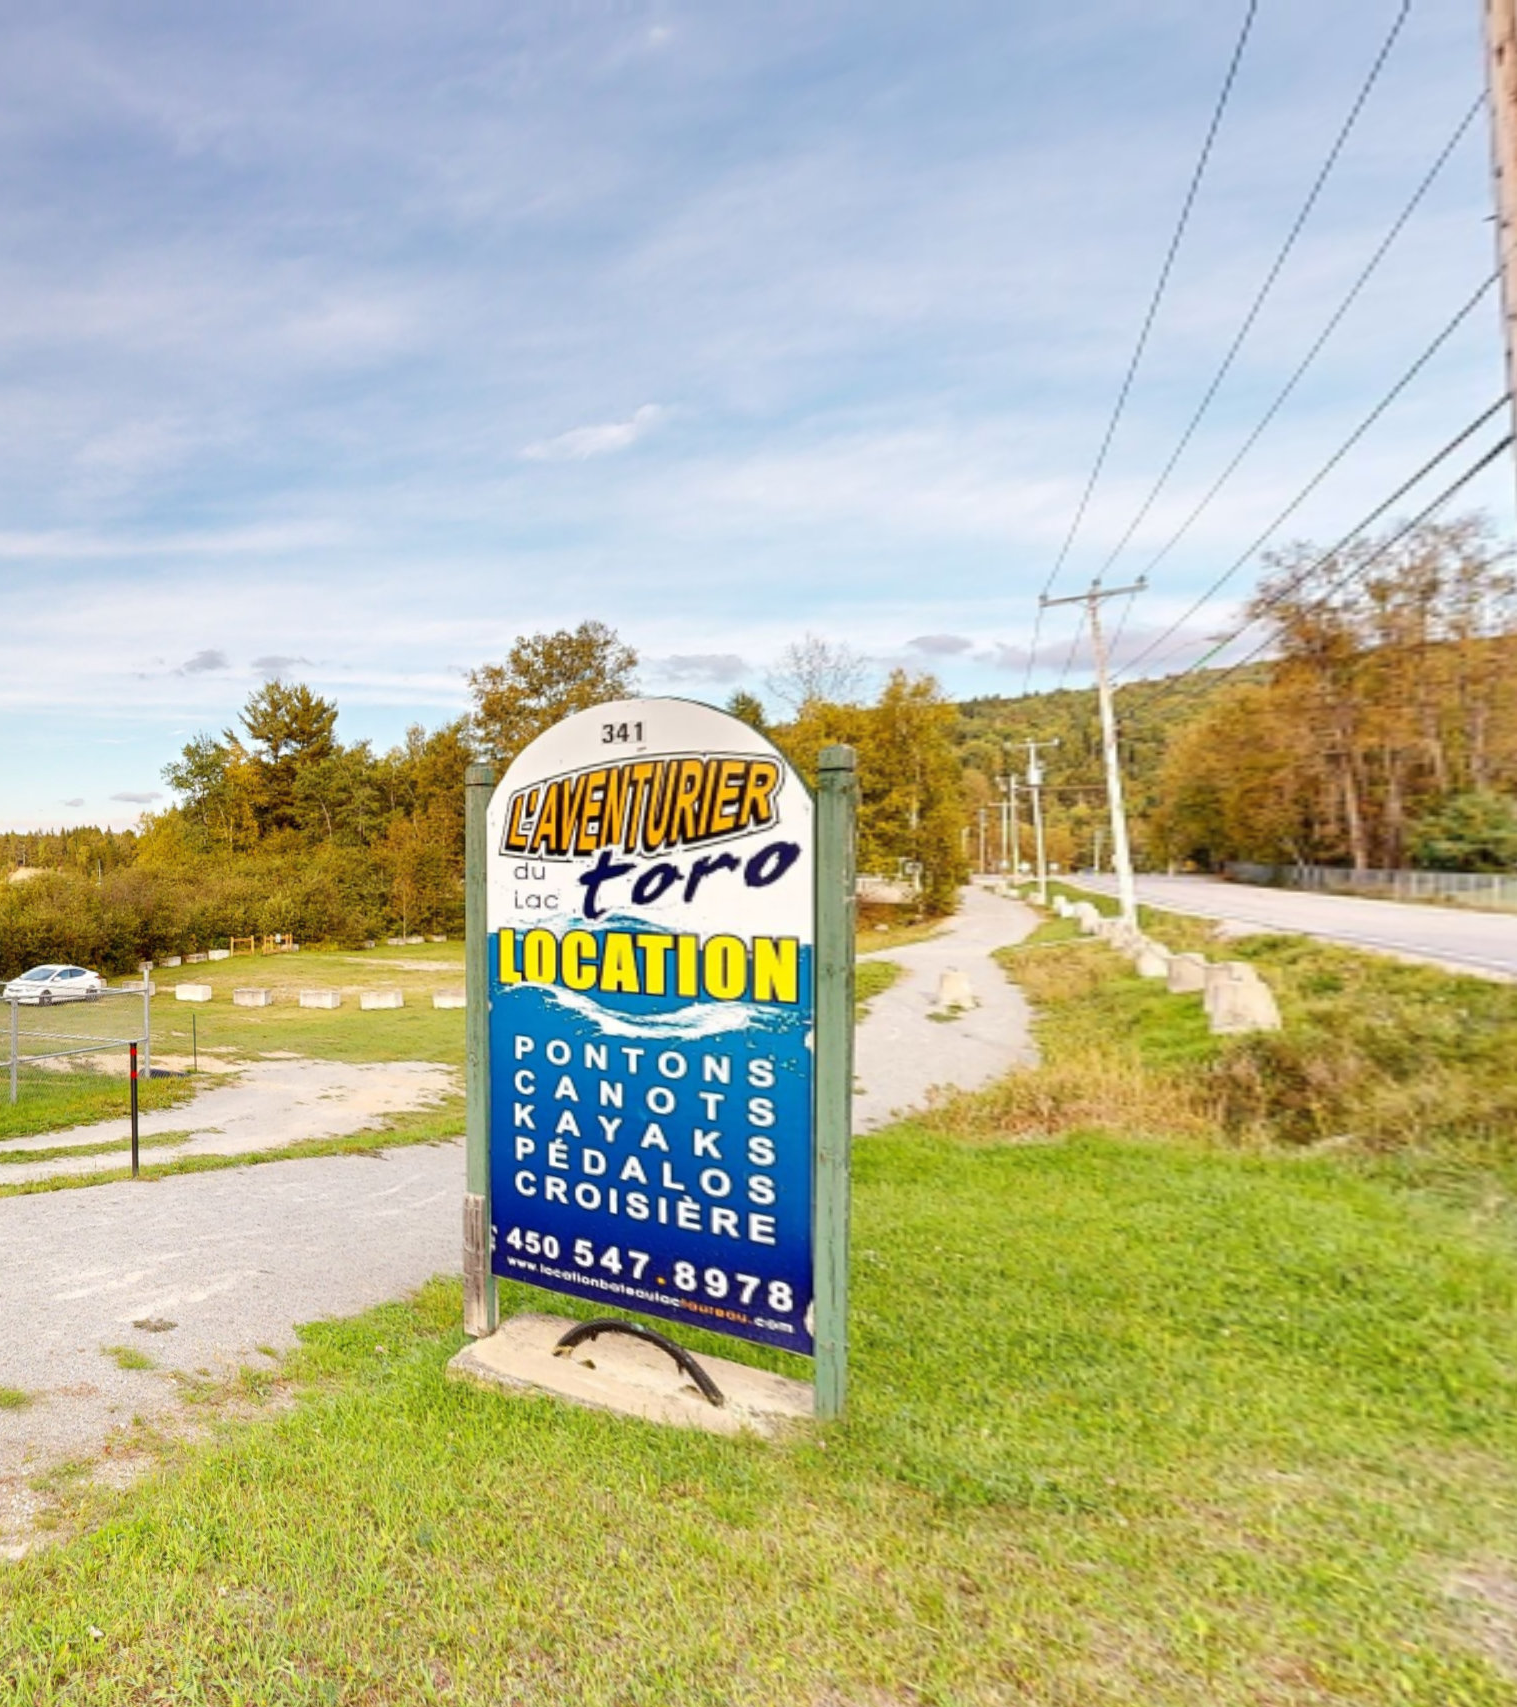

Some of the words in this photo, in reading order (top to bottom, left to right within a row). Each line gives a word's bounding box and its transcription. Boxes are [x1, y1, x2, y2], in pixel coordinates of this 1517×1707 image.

[602, 722, 644, 744] 341
[503, 757, 782, 856] L'AVENTURIER
[514, 862, 546, 881] du
[514, 890, 559, 911] Lac
[577, 841, 801, 919] toro
[497, 927, 799, 1004] LOCATION
[514, 1035, 777, 1089] PONTONS
[514, 1070, 777, 1128] CANOTS
[514, 1103, 777, 1167] KAYAKS
[514, 1136, 777, 1206] PÉDALOS
[514, 1171, 778, 1246] CROISIÈRE
[506, 1226, 560, 1260] 450
